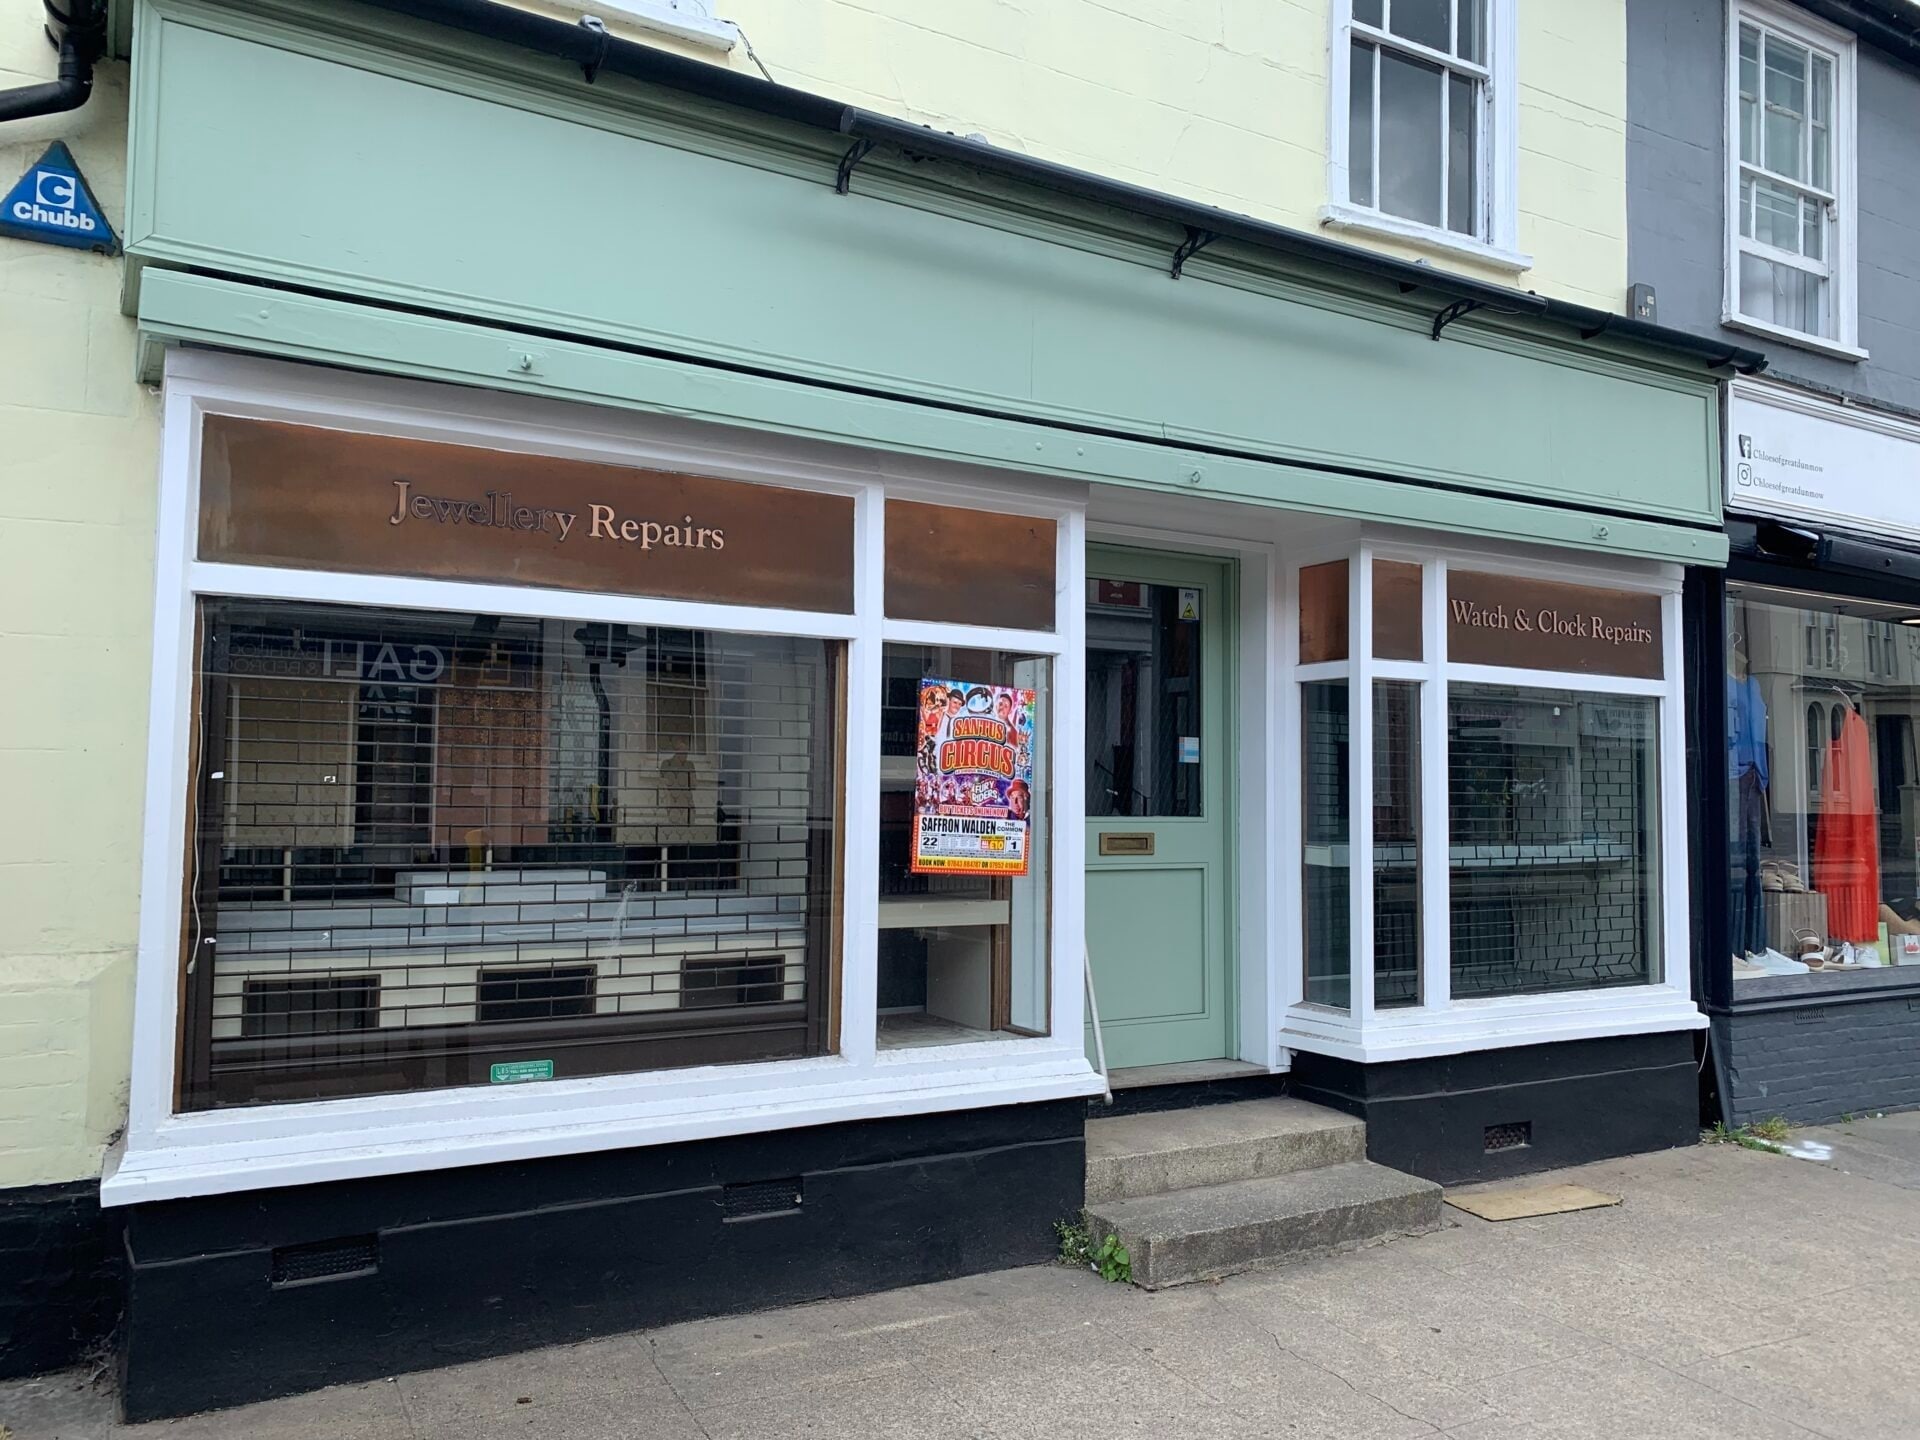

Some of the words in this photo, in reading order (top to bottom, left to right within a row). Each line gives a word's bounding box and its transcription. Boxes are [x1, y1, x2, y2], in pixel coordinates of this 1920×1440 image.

[12, 201, 96, 231] Chubb
[1753, 449, 1823, 472] Chloesofgreatdunmow
[1753, 477, 1824, 499] Chloesofgreatdunmow
[389, 480, 577, 542] Jewellery
[587, 502, 726, 551] Repairs
[1450, 598, 1510, 630] Watch
[1513, 608, 1534, 632] &
[1537, 608, 1588, 637] Clock
[1590, 615, 1653, 646] Repairs
[953, 717, 1004, 742] SANTUS
[940, 738, 1014, 777] CIRCUS
[921, 817, 960, 833] SAFFRON
[961, 819, 997, 834] WALDEN
[922, 836, 938, 847] 22
[1010, 841, 1017, 850] 1
[918, 859, 932, 867] BOOK
